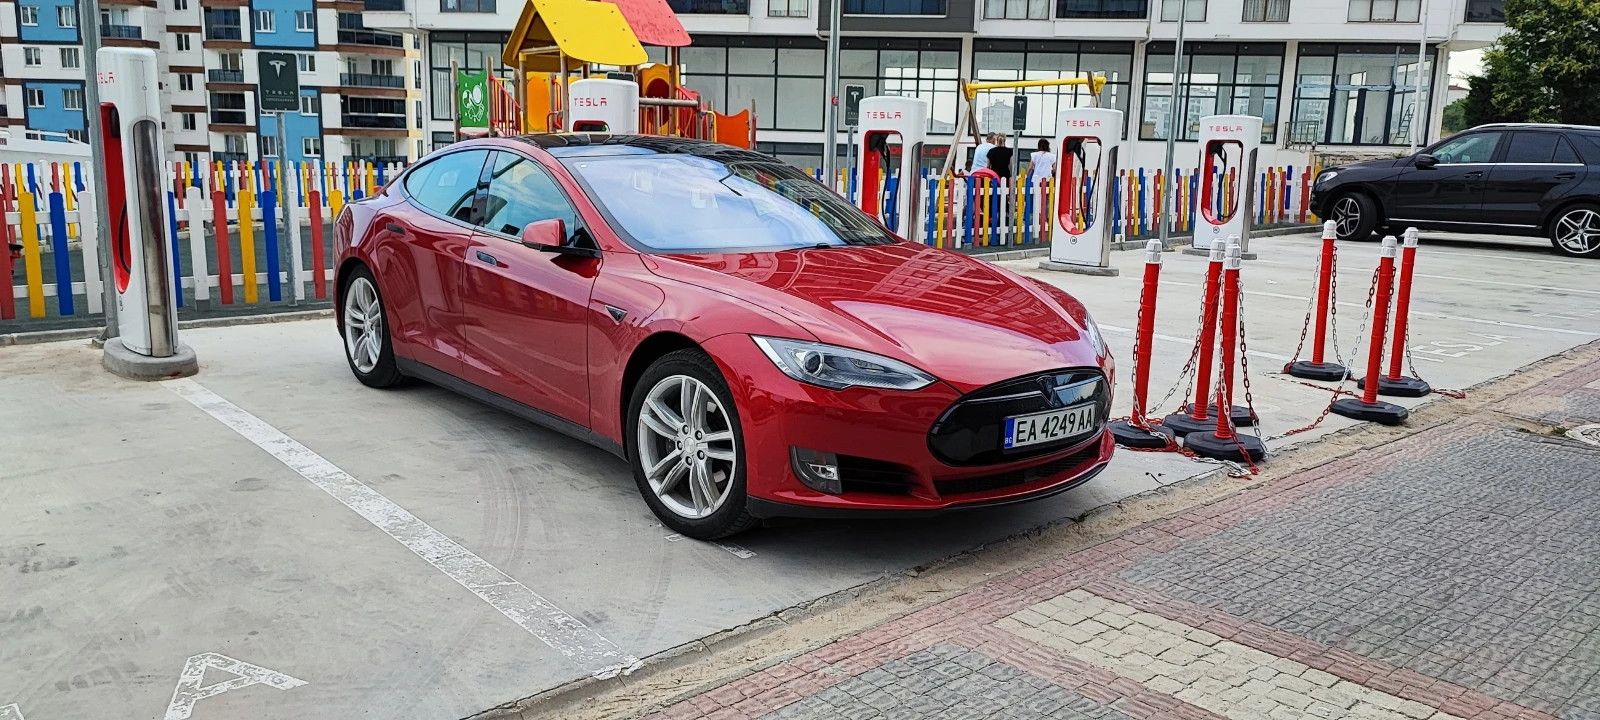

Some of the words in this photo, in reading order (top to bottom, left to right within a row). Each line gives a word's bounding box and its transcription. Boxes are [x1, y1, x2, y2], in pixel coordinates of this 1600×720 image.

[98, 72, 114, 83] SLA
[574, 98, 607, 106] TESLA
[866, 111, 902, 119] TESLA
[1016, 419, 1037, 443] EA
[1041, 412, 1076, 438] 4249
[1077, 408, 1092, 431] AA
